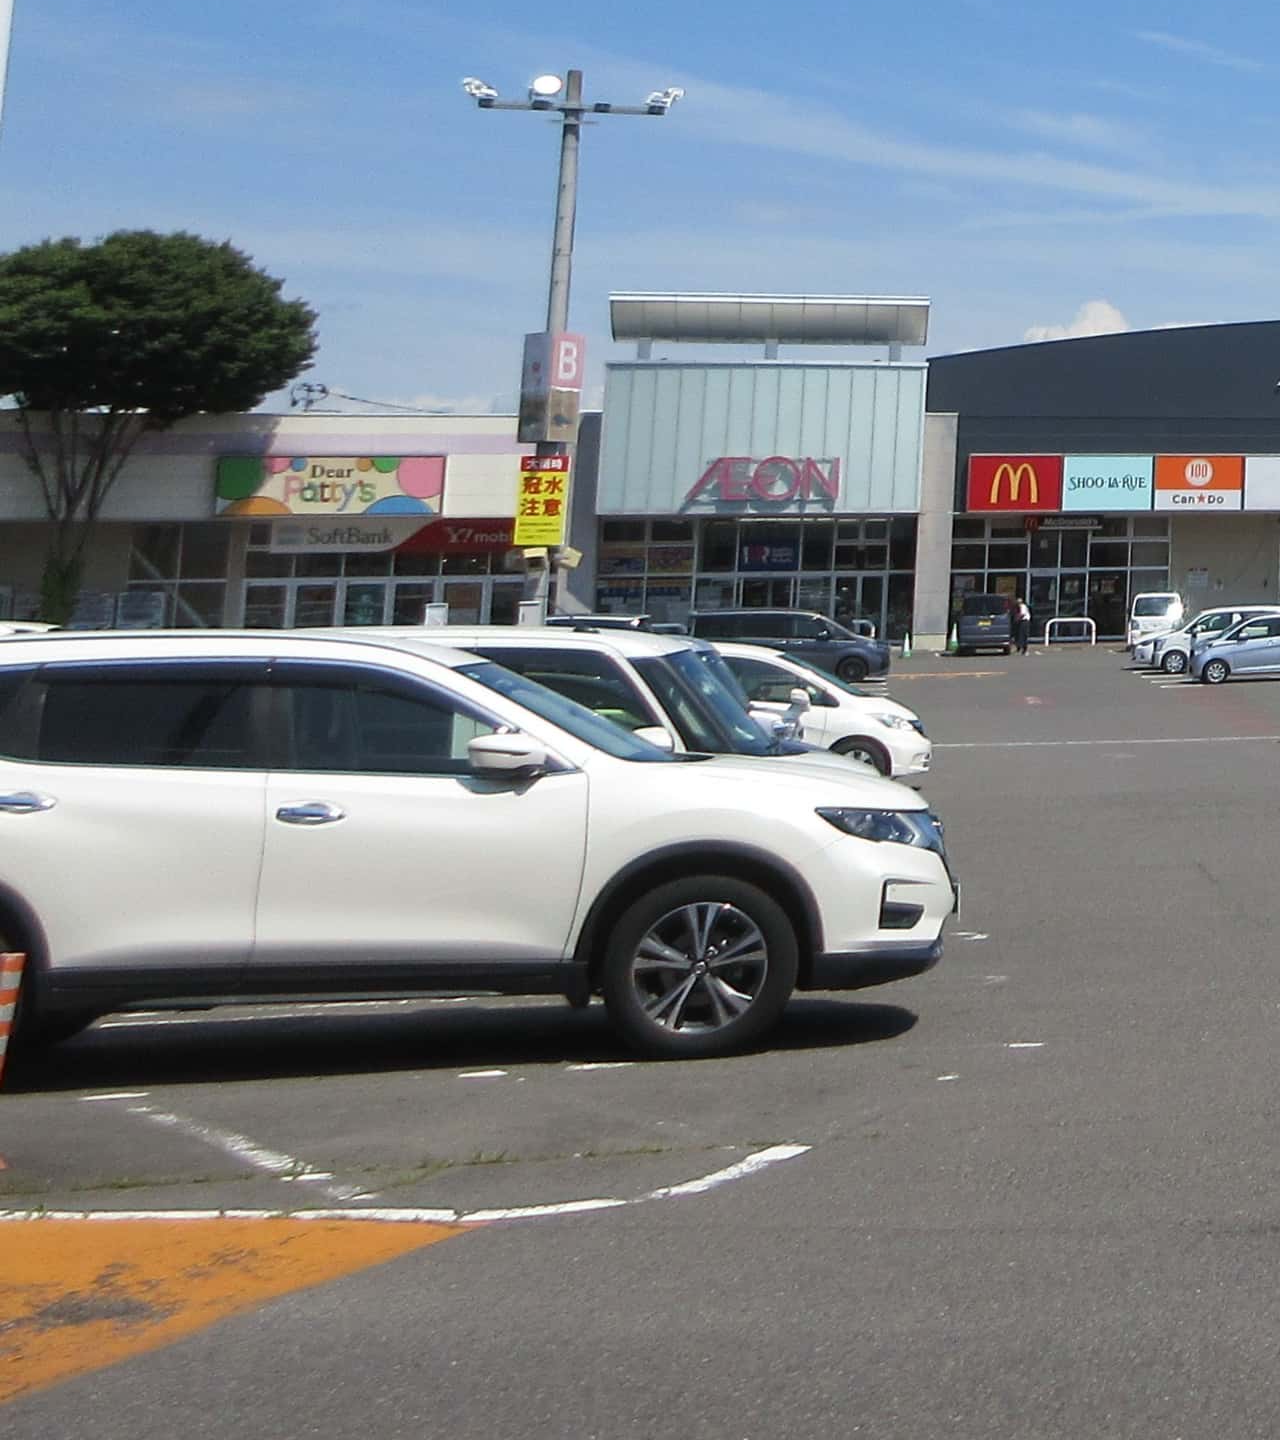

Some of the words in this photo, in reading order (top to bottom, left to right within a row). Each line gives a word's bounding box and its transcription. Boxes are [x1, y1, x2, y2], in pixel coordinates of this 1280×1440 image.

[558, 341, 577, 380] B
[311, 464, 354, 479] Dear
[284, 475, 376, 512] Patty's
[522, 476, 564, 495] 冠水
[520, 498, 562, 517] 注意
[306, 527, 392, 545] SoftBank
